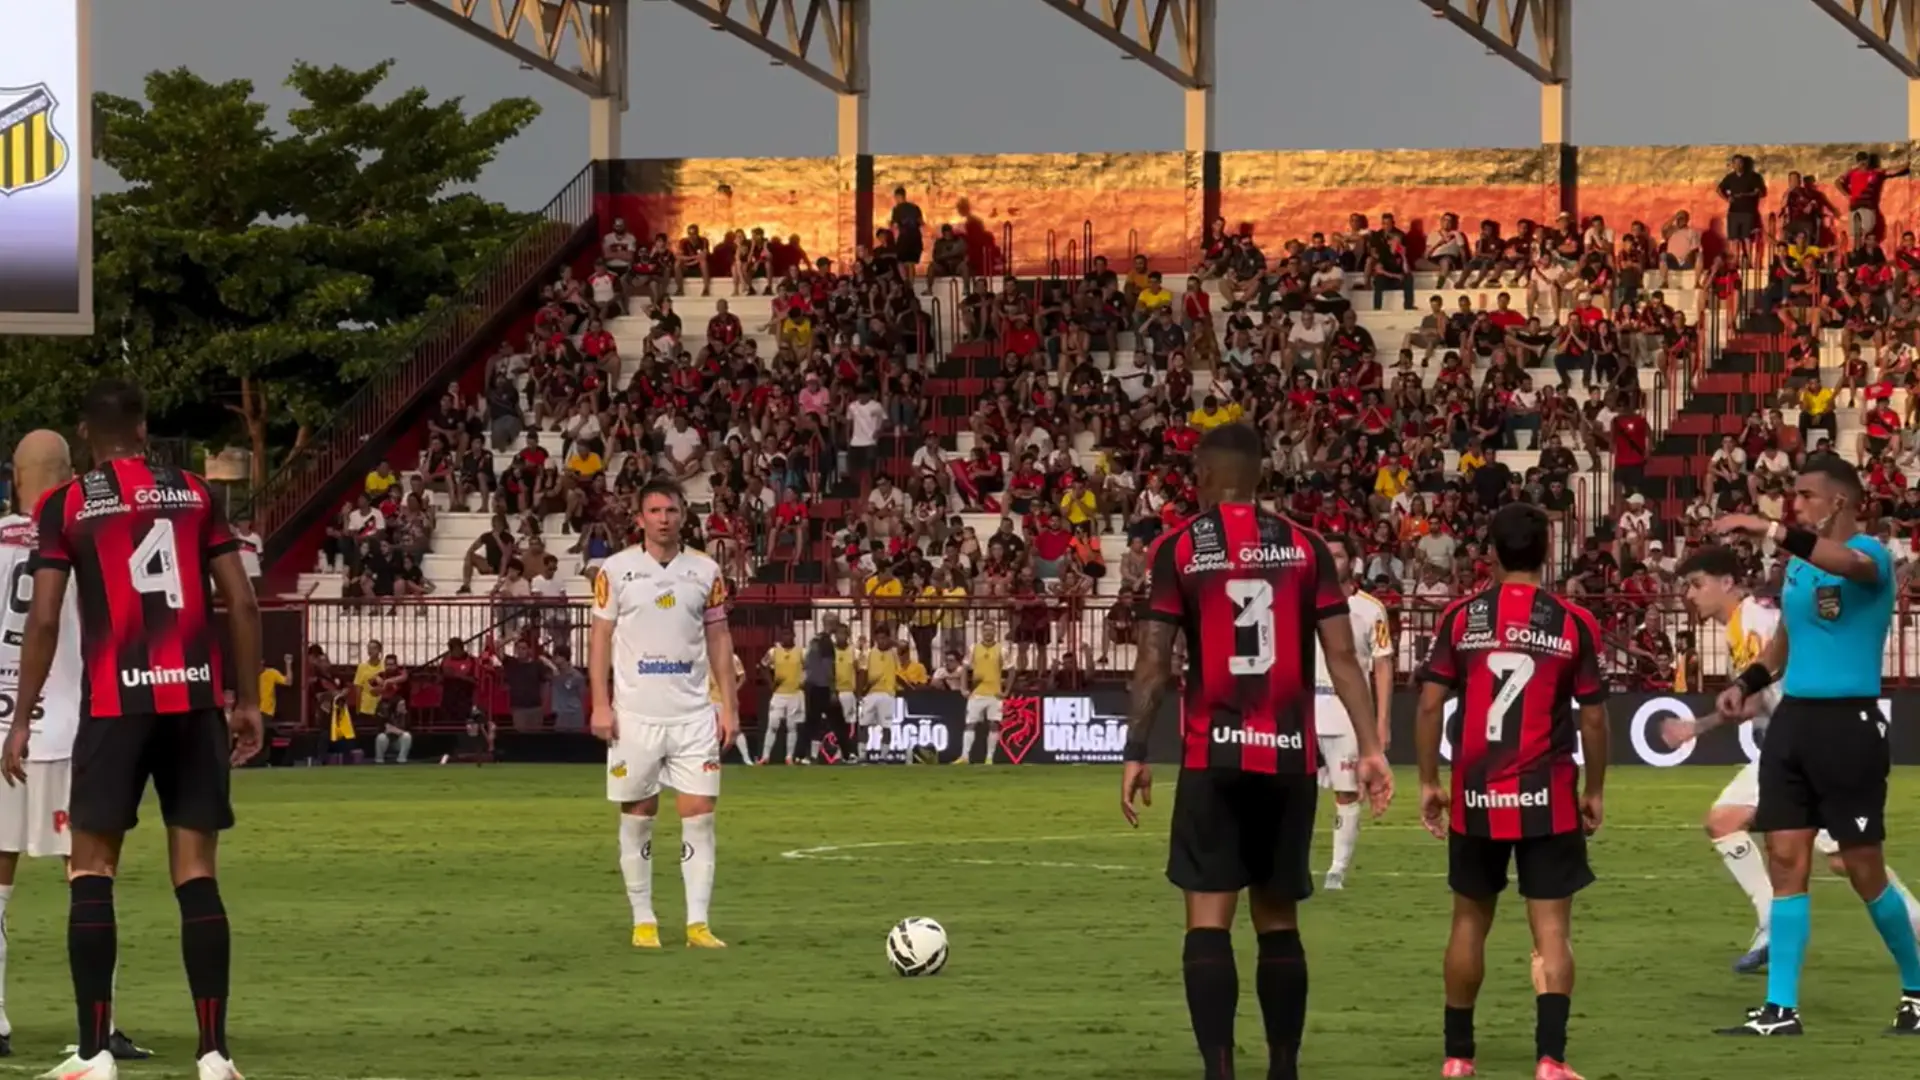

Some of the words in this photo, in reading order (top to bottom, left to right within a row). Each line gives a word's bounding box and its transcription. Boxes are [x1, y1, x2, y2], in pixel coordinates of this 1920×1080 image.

[134, 487, 203, 504] GOIÂNIA
[129, 518, 185, 609] 4
[1239, 544, 1306, 562] GOIÂNIA
[1225, 578, 1277, 675] 3
[1504, 627, 1573, 653] GOIÂNIA
[122, 663, 210, 687] Unimed
[1486, 651, 1537, 742] 7
[1043, 696, 1091, 724] MEU
[1212, 725, 1302, 750] Unimed
[1464, 787, 1549, 809] Unimed
